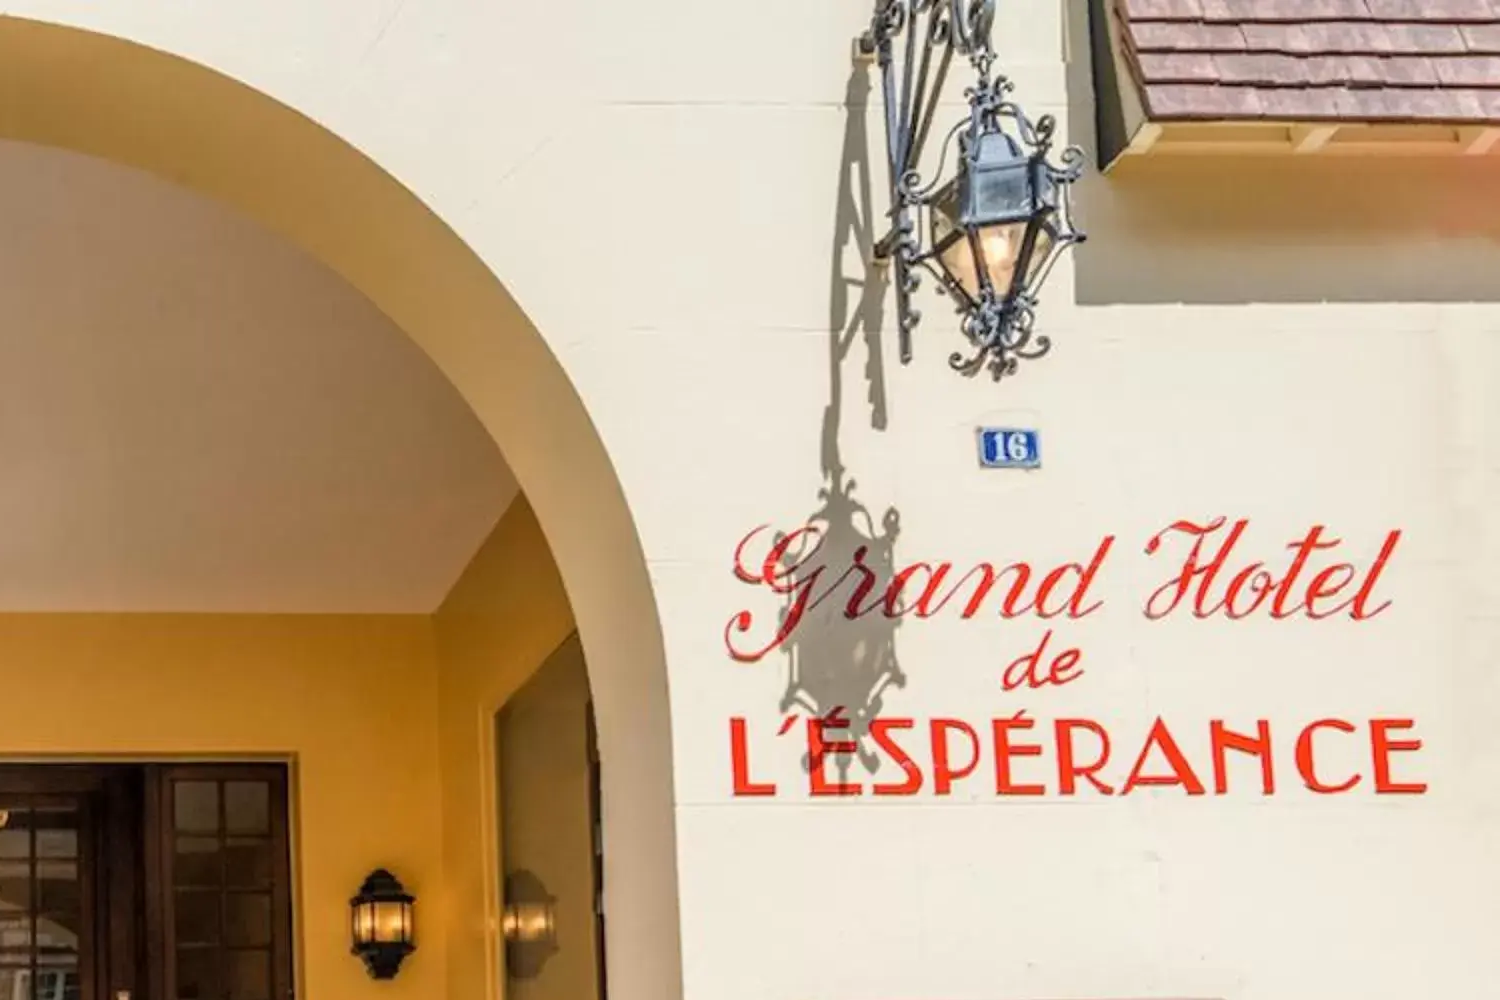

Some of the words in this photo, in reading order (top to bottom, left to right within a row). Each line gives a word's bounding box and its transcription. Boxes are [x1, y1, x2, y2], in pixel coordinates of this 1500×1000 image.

[994, 432, 1028, 461] 16
[723, 522, 1116, 663] Grand
[1144, 515, 1403, 623] Hotel
[1000, 628, 1084, 692] de
